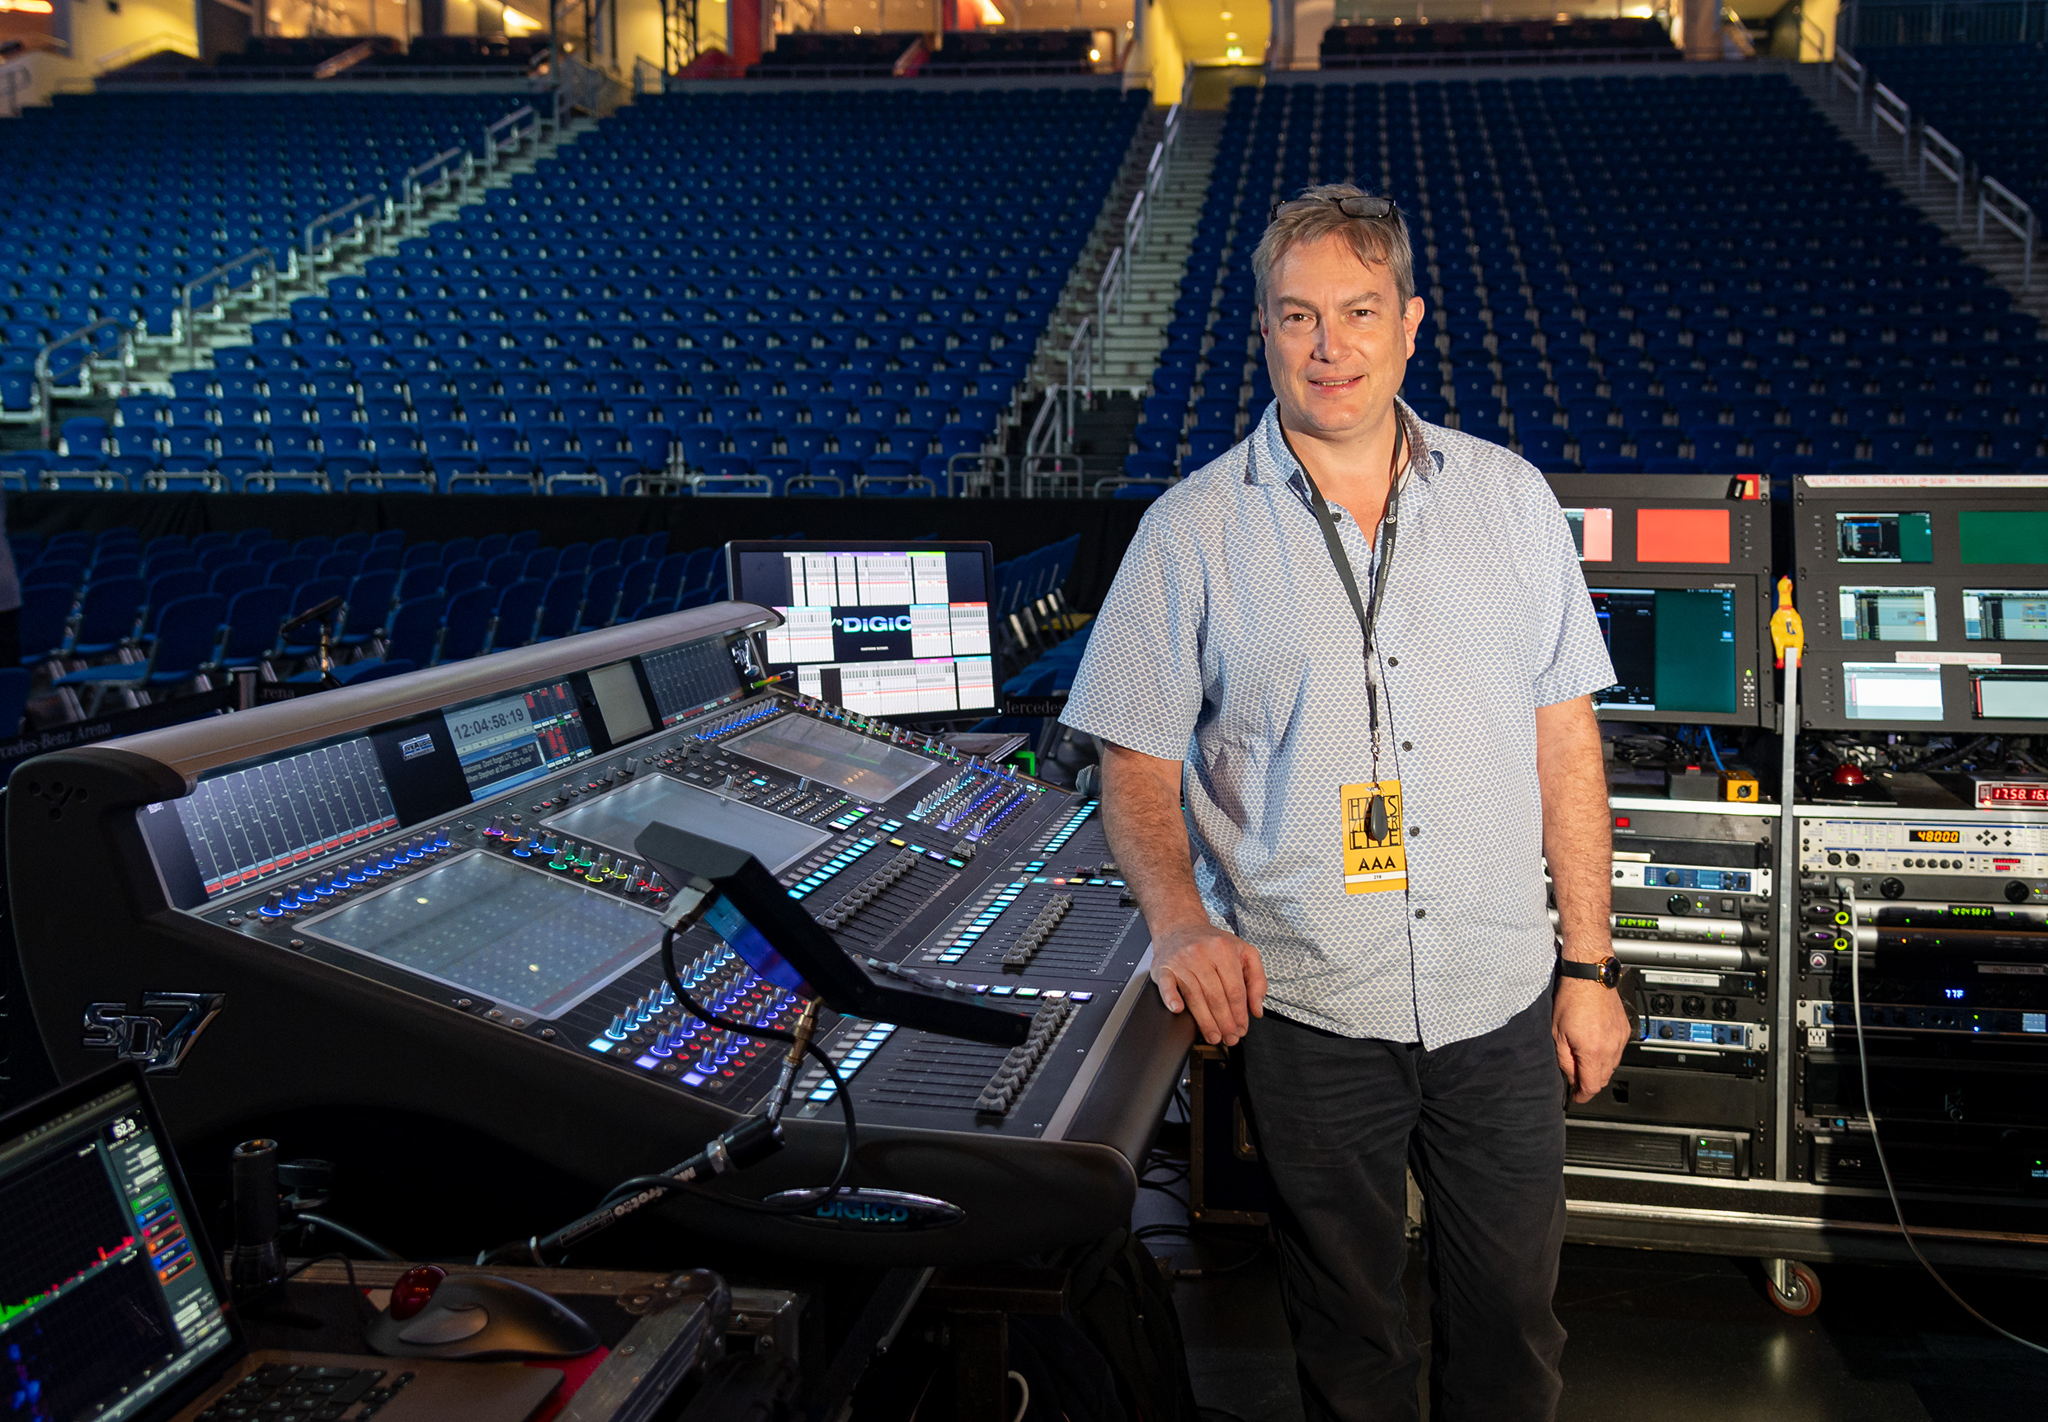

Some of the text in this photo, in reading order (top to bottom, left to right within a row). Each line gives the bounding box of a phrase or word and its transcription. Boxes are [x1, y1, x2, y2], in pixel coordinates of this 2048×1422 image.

[262, 687, 295, 699] rena
[454, 708, 524, 740] 12:04:58:19
[1350, 796, 1398, 820] HS
[1352, 828, 1399, 849] LIE
[1917, 830, 1959, 843] 48000
[1358, 856, 1396, 871] AAA
[82, 991, 226, 1076] SD7
[614, 1166, 697, 1217] Mfrotto
